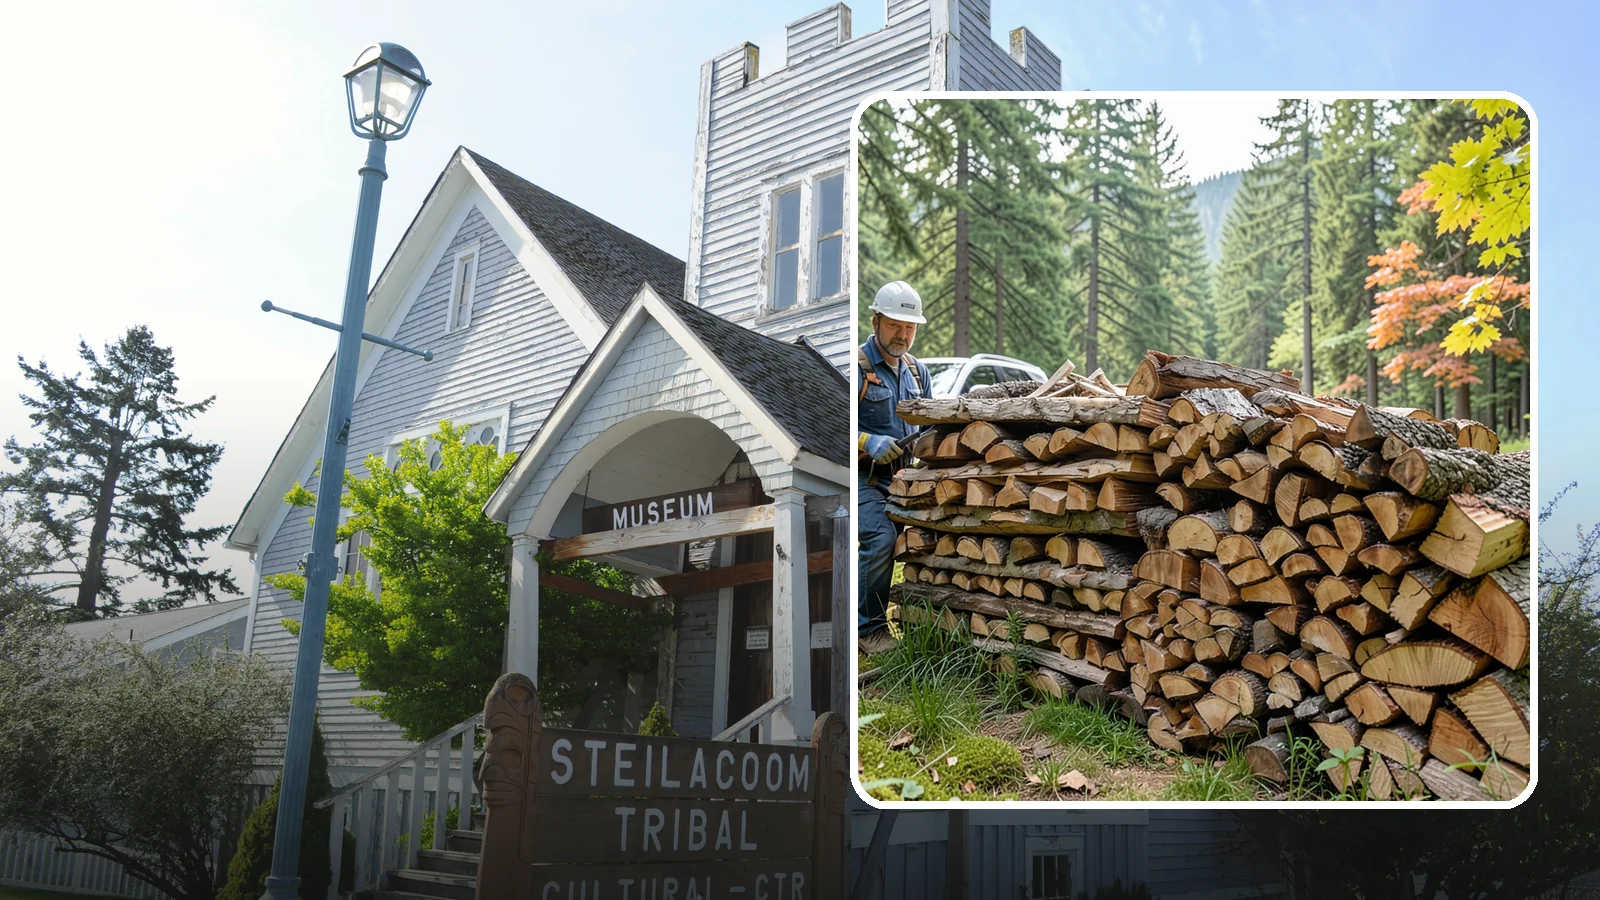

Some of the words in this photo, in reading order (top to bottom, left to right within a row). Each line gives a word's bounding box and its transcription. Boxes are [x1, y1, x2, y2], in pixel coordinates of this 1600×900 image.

[613, 491, 713, 530] MUSEUM
[550, 738, 809, 792] STEILACOOM
[615, 807, 757, 851] TRIBAL
